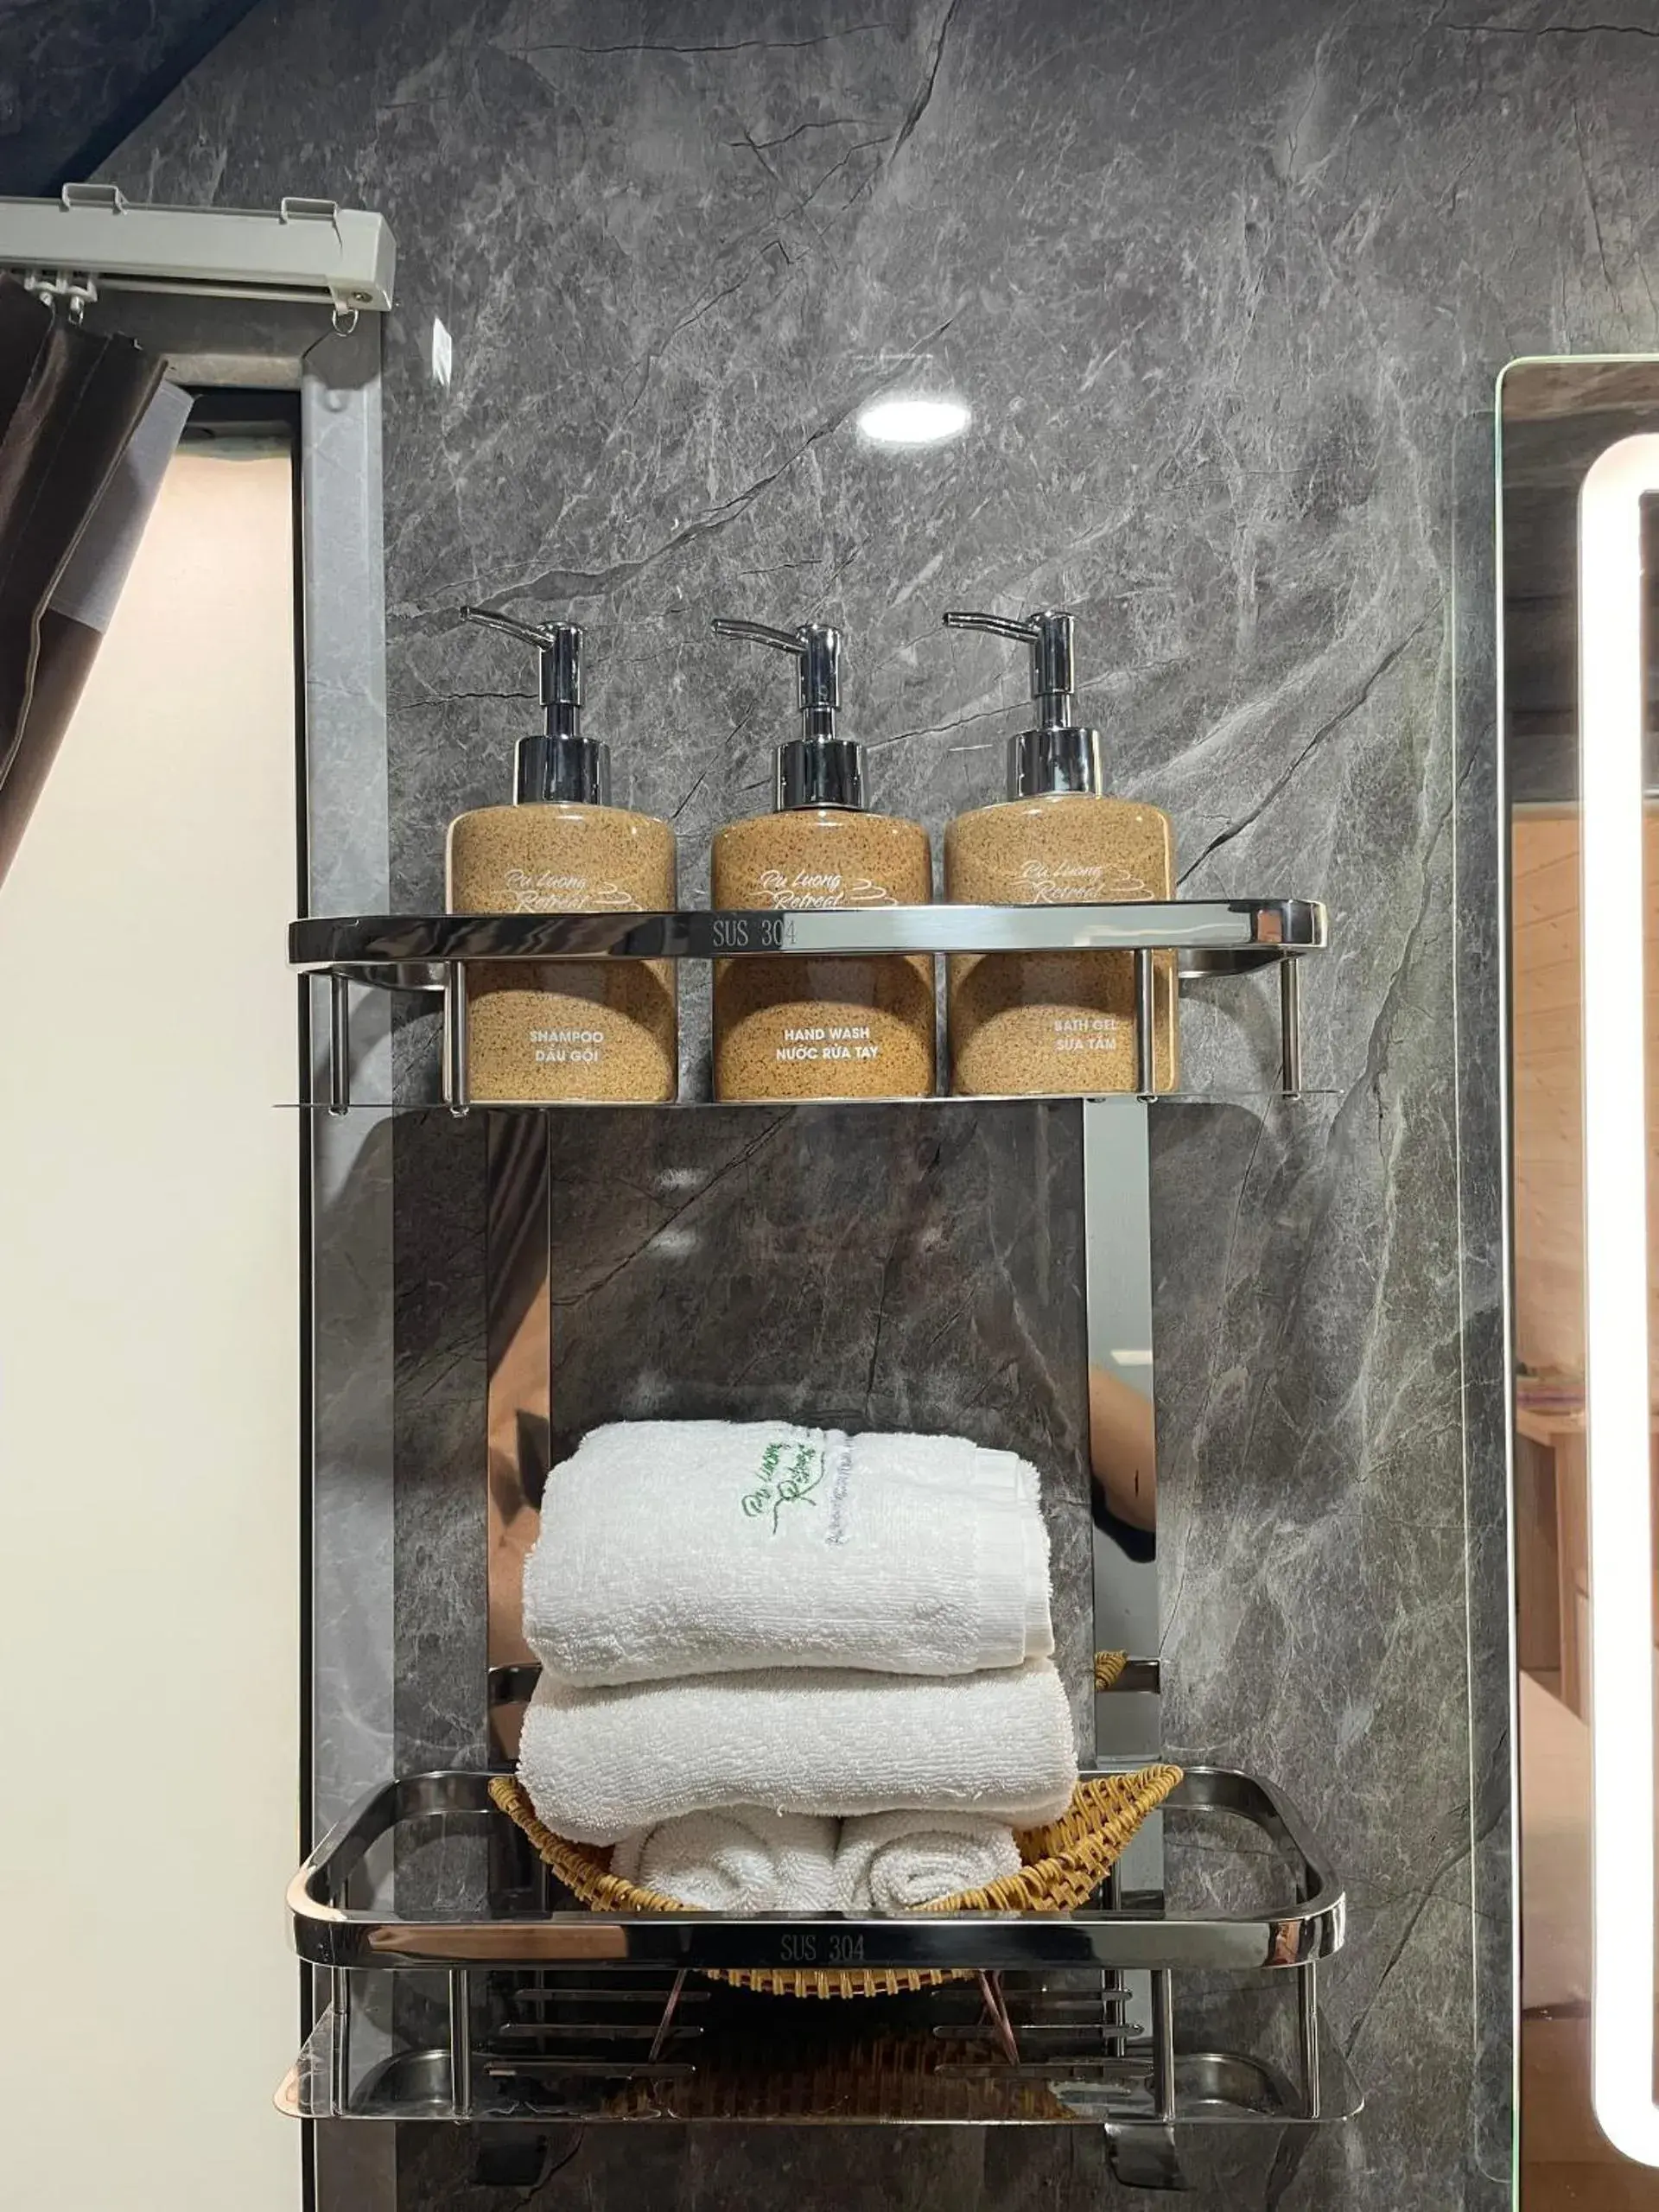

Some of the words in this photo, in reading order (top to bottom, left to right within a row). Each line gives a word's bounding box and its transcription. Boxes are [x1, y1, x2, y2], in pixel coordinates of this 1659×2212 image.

[760, 869, 788, 888] Pu
[713, 919, 749, 948] SUS
[761, 918, 797, 948] 304
[1054, 1020, 1089, 1032] BATH
[1091, 1019, 1118, 1032] GEL
[530, 1031, 604, 1044] SHAMPOO
[784, 1028, 825, 1041] HAND
[830, 1027, 870, 1039] WASH
[855, 1046, 879, 1059] TAY
[780, 1934, 817, 1961] SUS
[829, 1935, 864, 1961] 304
